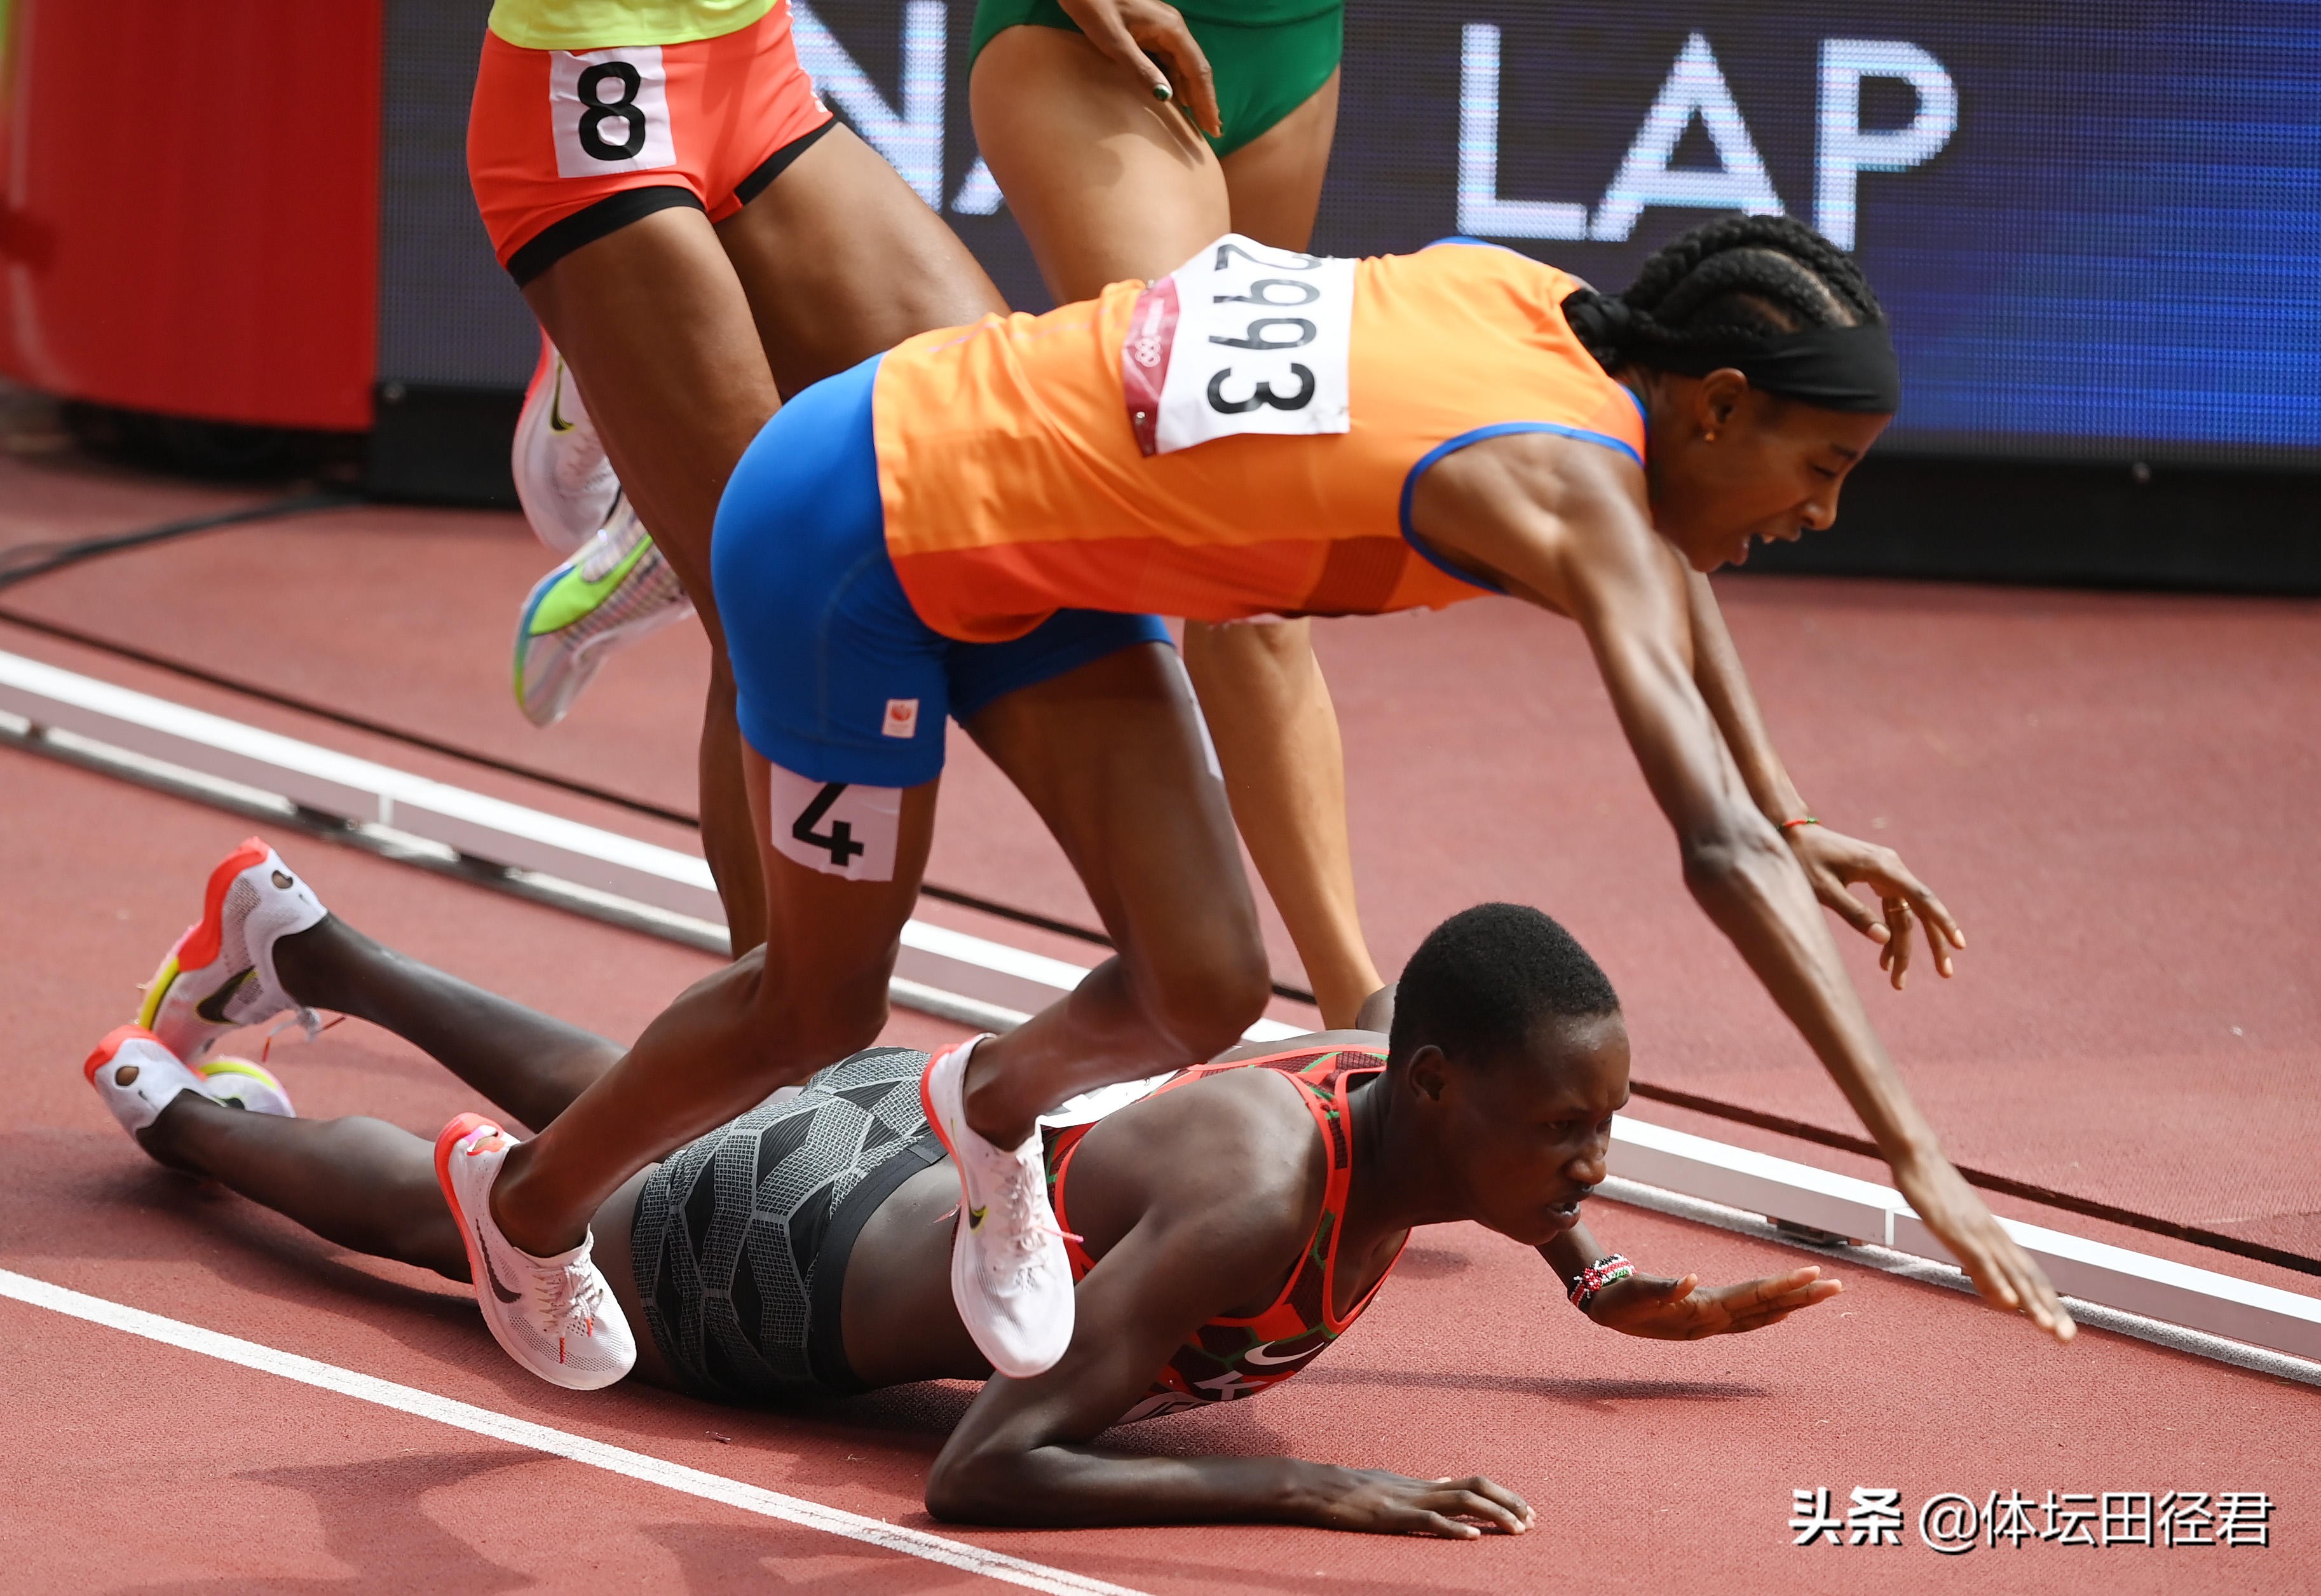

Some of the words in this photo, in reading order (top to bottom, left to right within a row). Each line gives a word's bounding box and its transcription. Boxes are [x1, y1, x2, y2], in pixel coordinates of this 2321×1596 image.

[576, 61, 646, 161] 8
[791, 0, 1004, 215] N
[1456, 23, 1959, 252] LAP
[1207, 243, 1323, 414] 2993
[792, 782, 864, 866] 4
